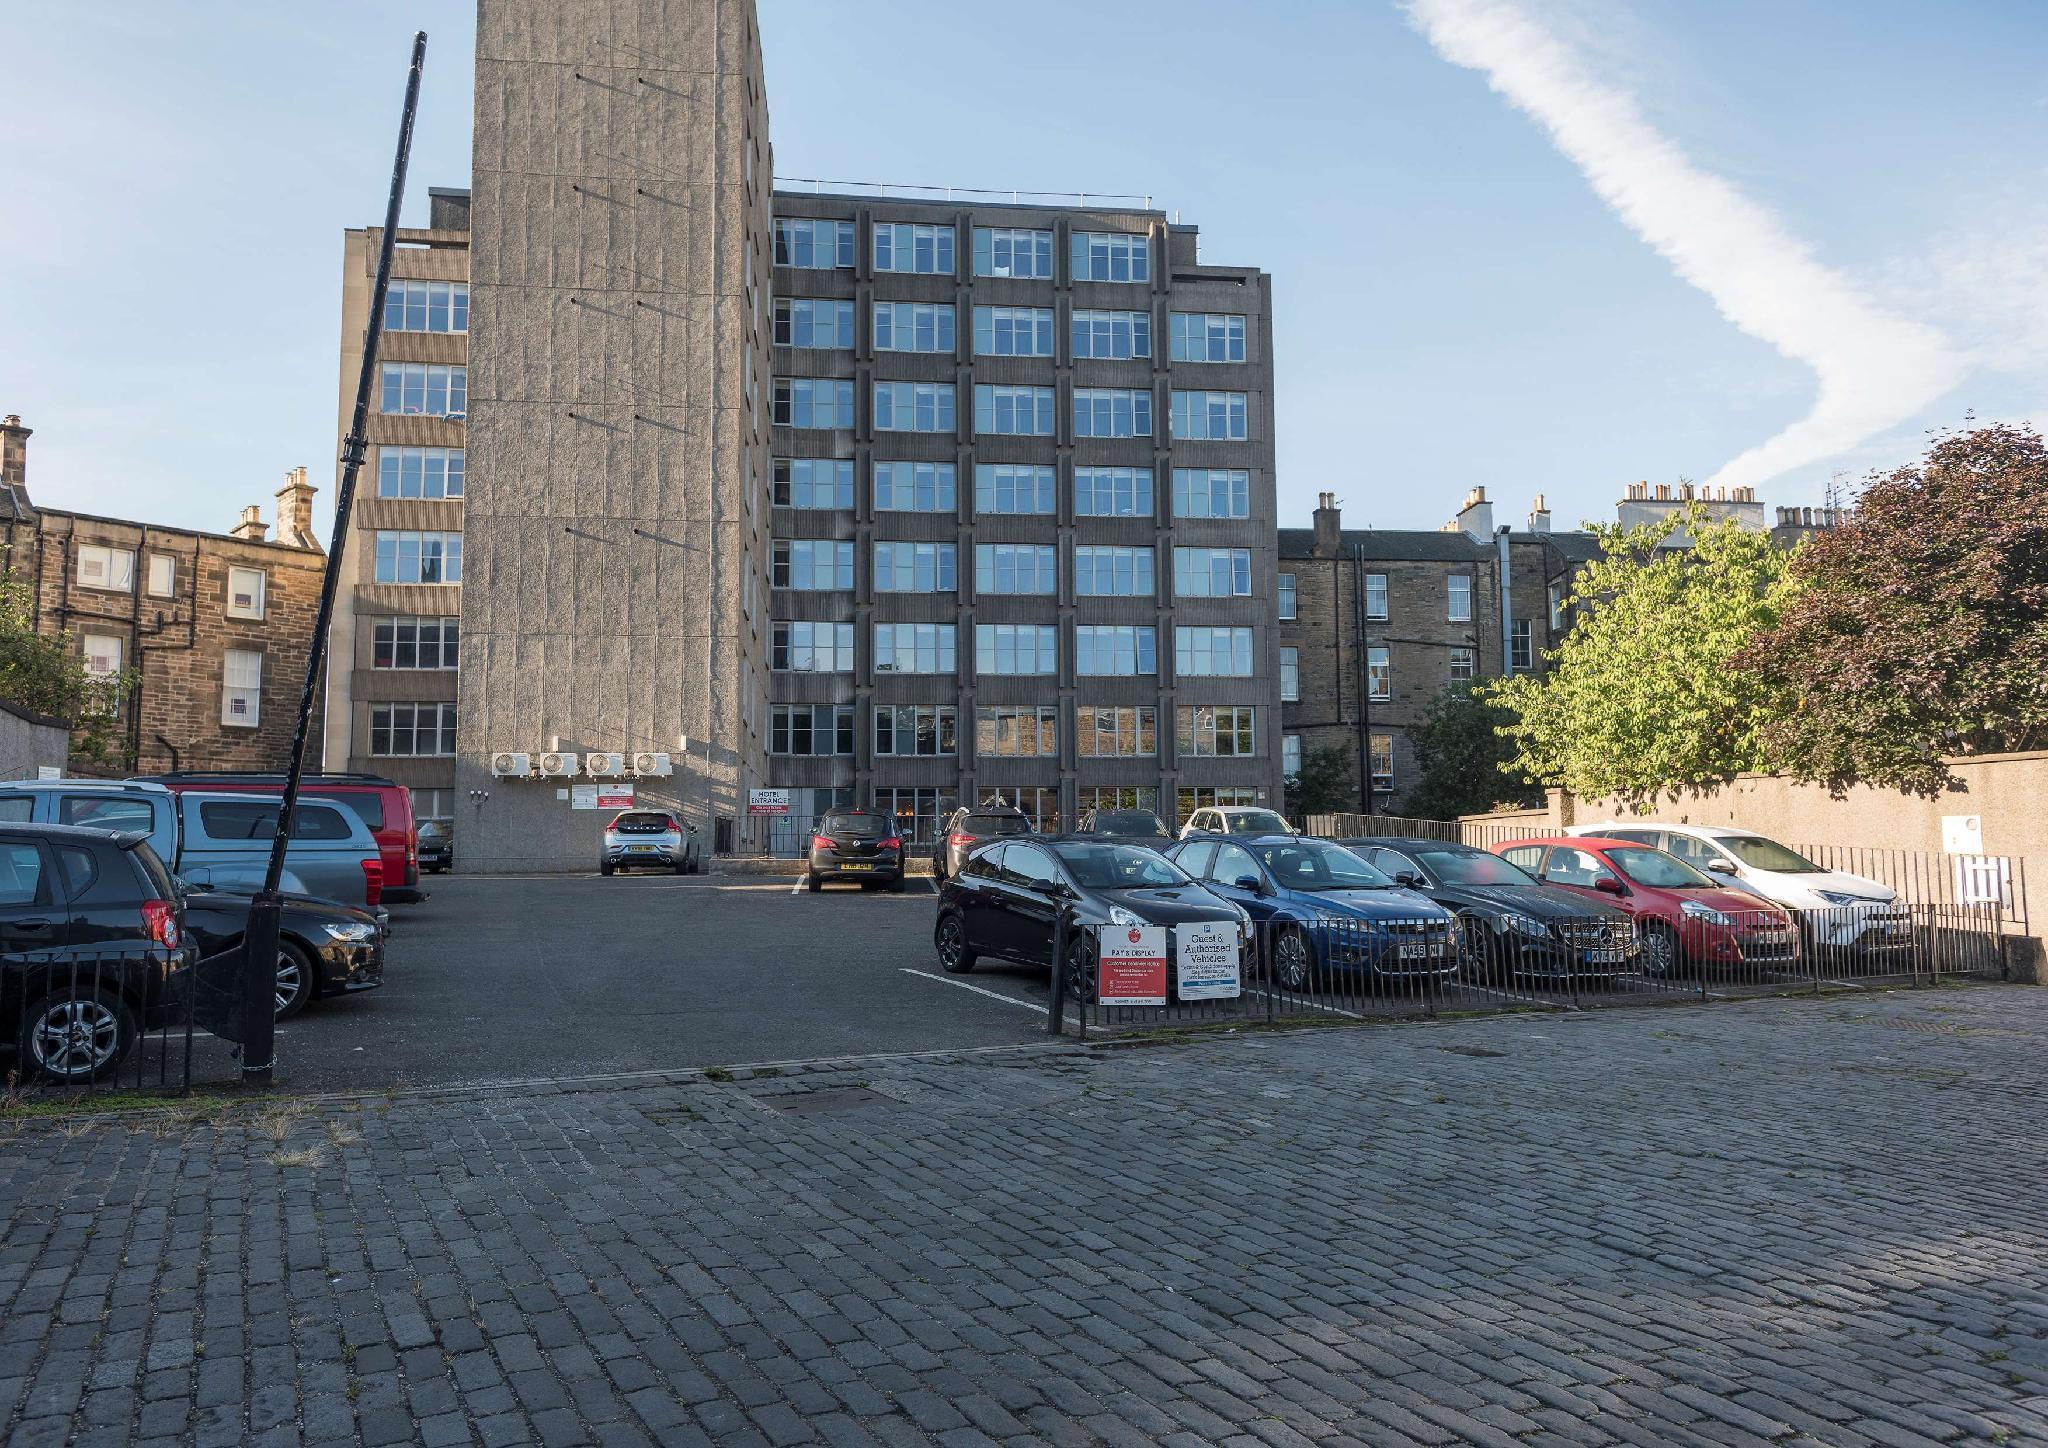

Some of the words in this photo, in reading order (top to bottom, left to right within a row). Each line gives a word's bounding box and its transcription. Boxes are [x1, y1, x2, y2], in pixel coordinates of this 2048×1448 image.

[1191, 934, 1216, 943] Guest
[1217, 933, 1224, 943] &
[1184, 943, 1231, 954] Authorised
[1190, 954, 1226, 963] Vehicles
